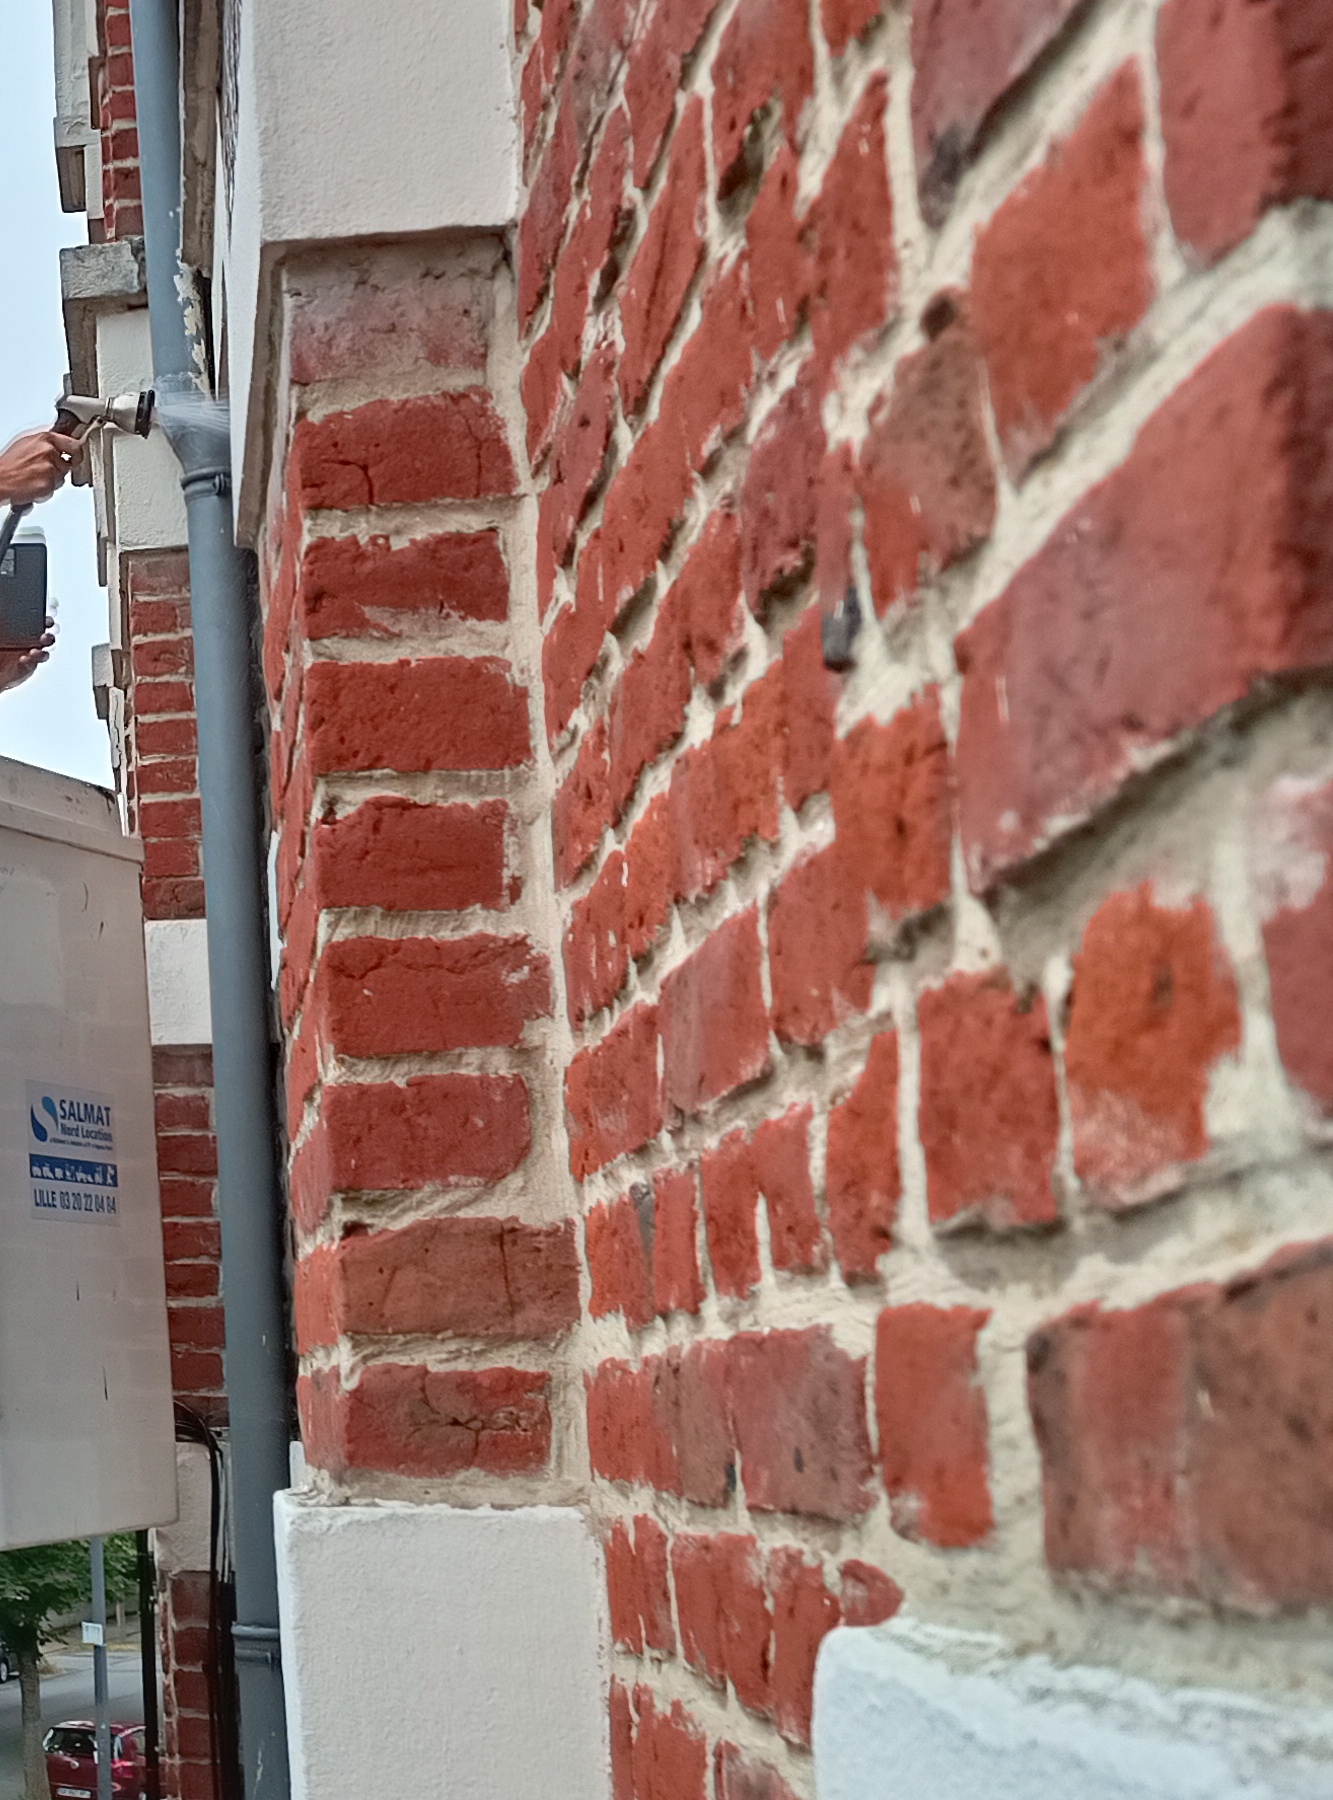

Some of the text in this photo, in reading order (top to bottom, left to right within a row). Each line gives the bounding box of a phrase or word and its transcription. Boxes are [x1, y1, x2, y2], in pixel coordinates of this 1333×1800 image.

[59, 1099, 111, 1127] SALMAT
[60, 1123, 113, 1142] Nord Location
[34, 1189, 57, 1208] LILLE
[59, 1190, 70, 1210] 03
[72, 1192, 82, 1211] 20
[83, 1192, 93, 1212] 22
